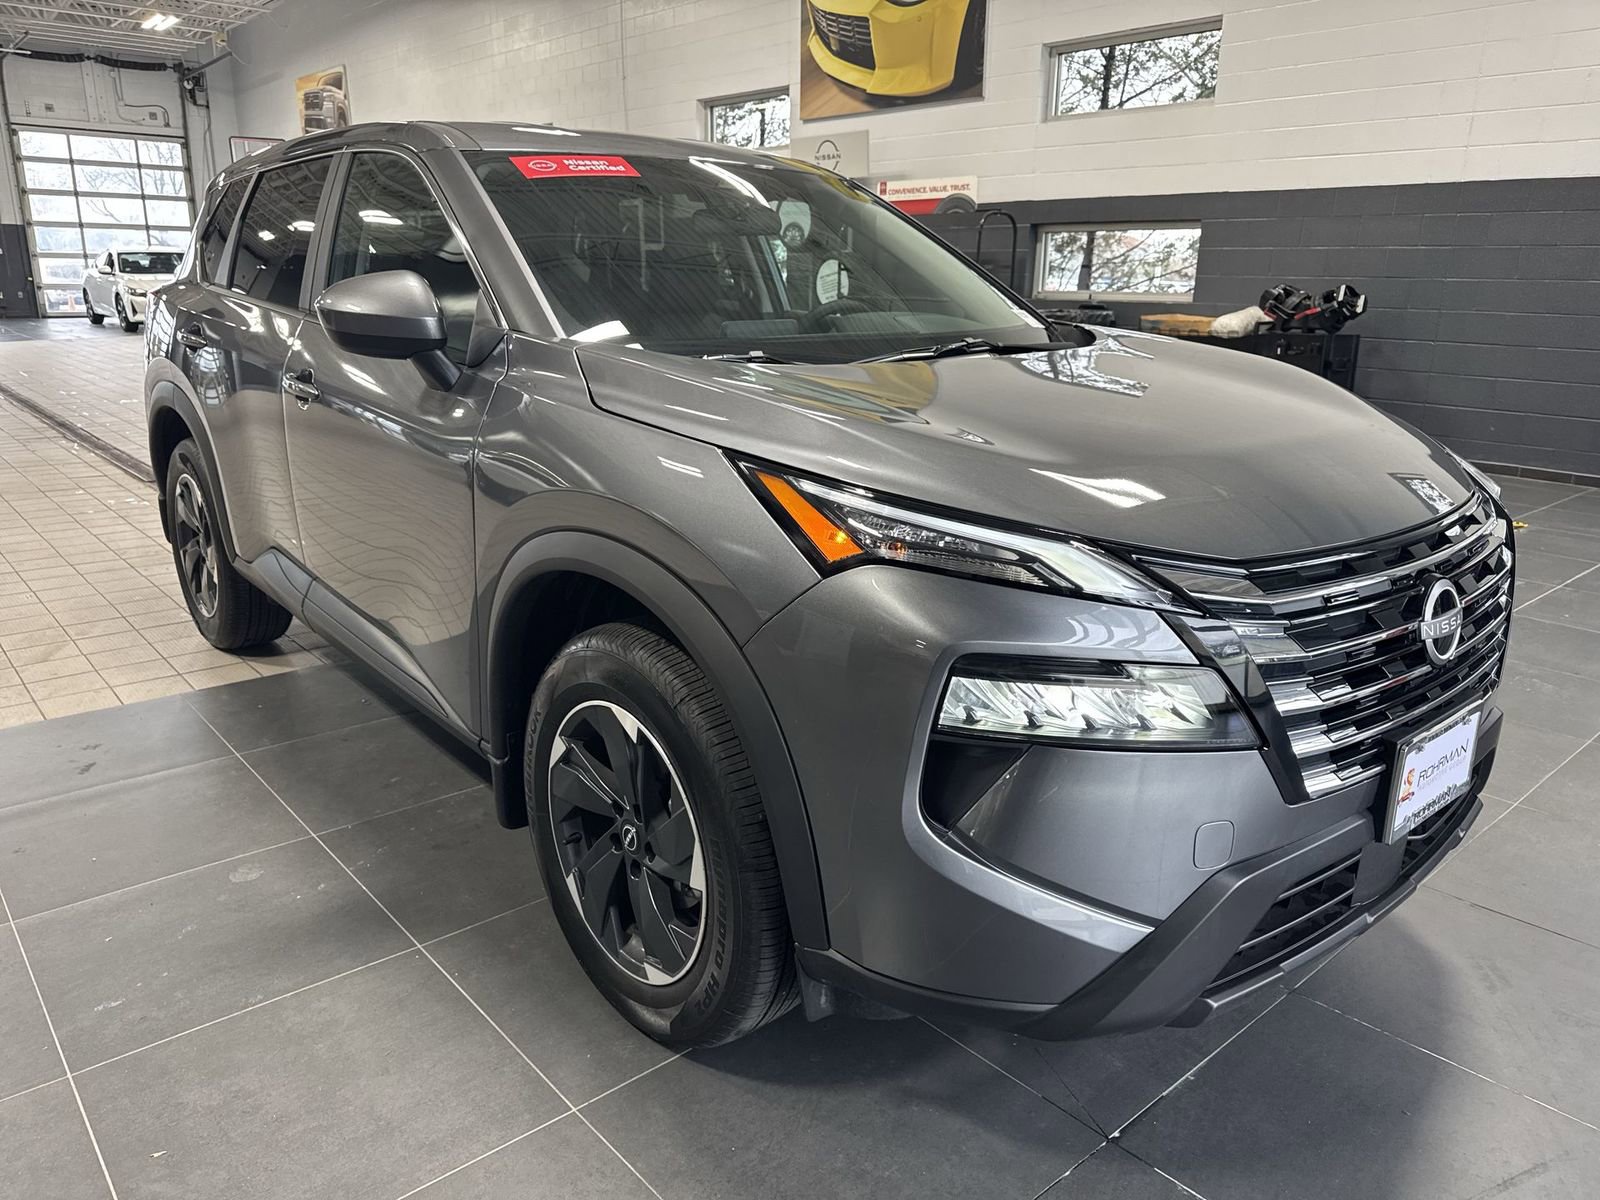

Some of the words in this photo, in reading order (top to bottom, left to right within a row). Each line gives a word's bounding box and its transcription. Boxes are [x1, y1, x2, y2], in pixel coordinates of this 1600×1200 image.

[814, 153, 841, 161] NISSAN
[888, 186, 928, 195] CONVENIENCE.
[929, 185, 949, 193] VALUE.
[950, 183, 971, 191] TRUST.
[1423, 614, 1461, 637] NISSA
[1417, 738, 1469, 787] ROHRMAN
